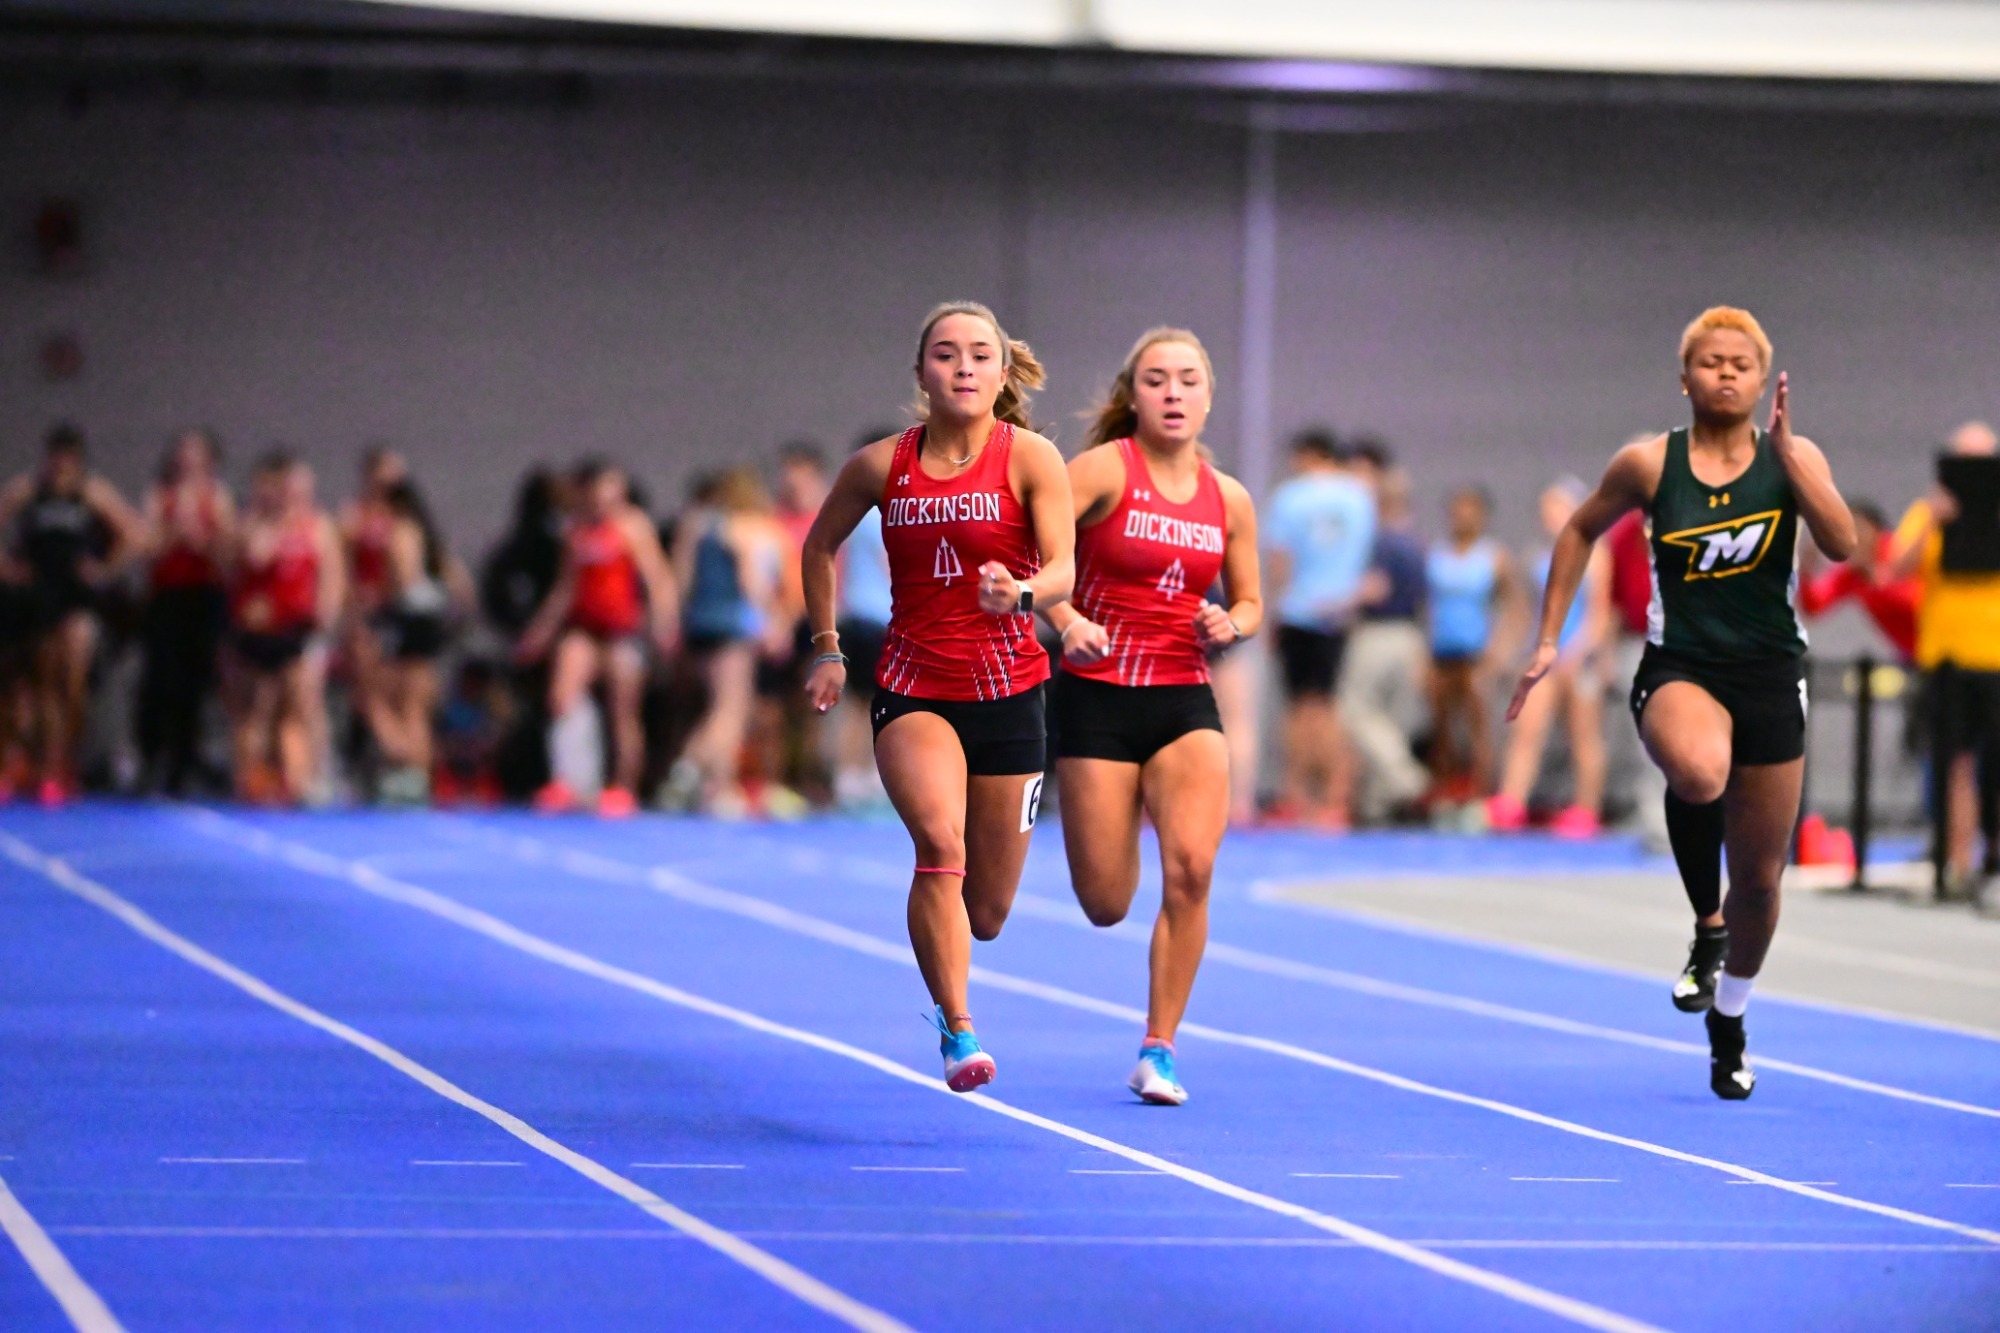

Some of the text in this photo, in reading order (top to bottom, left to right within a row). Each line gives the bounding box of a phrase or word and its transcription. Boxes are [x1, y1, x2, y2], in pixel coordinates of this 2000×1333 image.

[887, 492, 1001, 527] DICKINSON
[1124, 510, 1223, 554] DICKINSON
[1698, 522, 1766, 571] M
